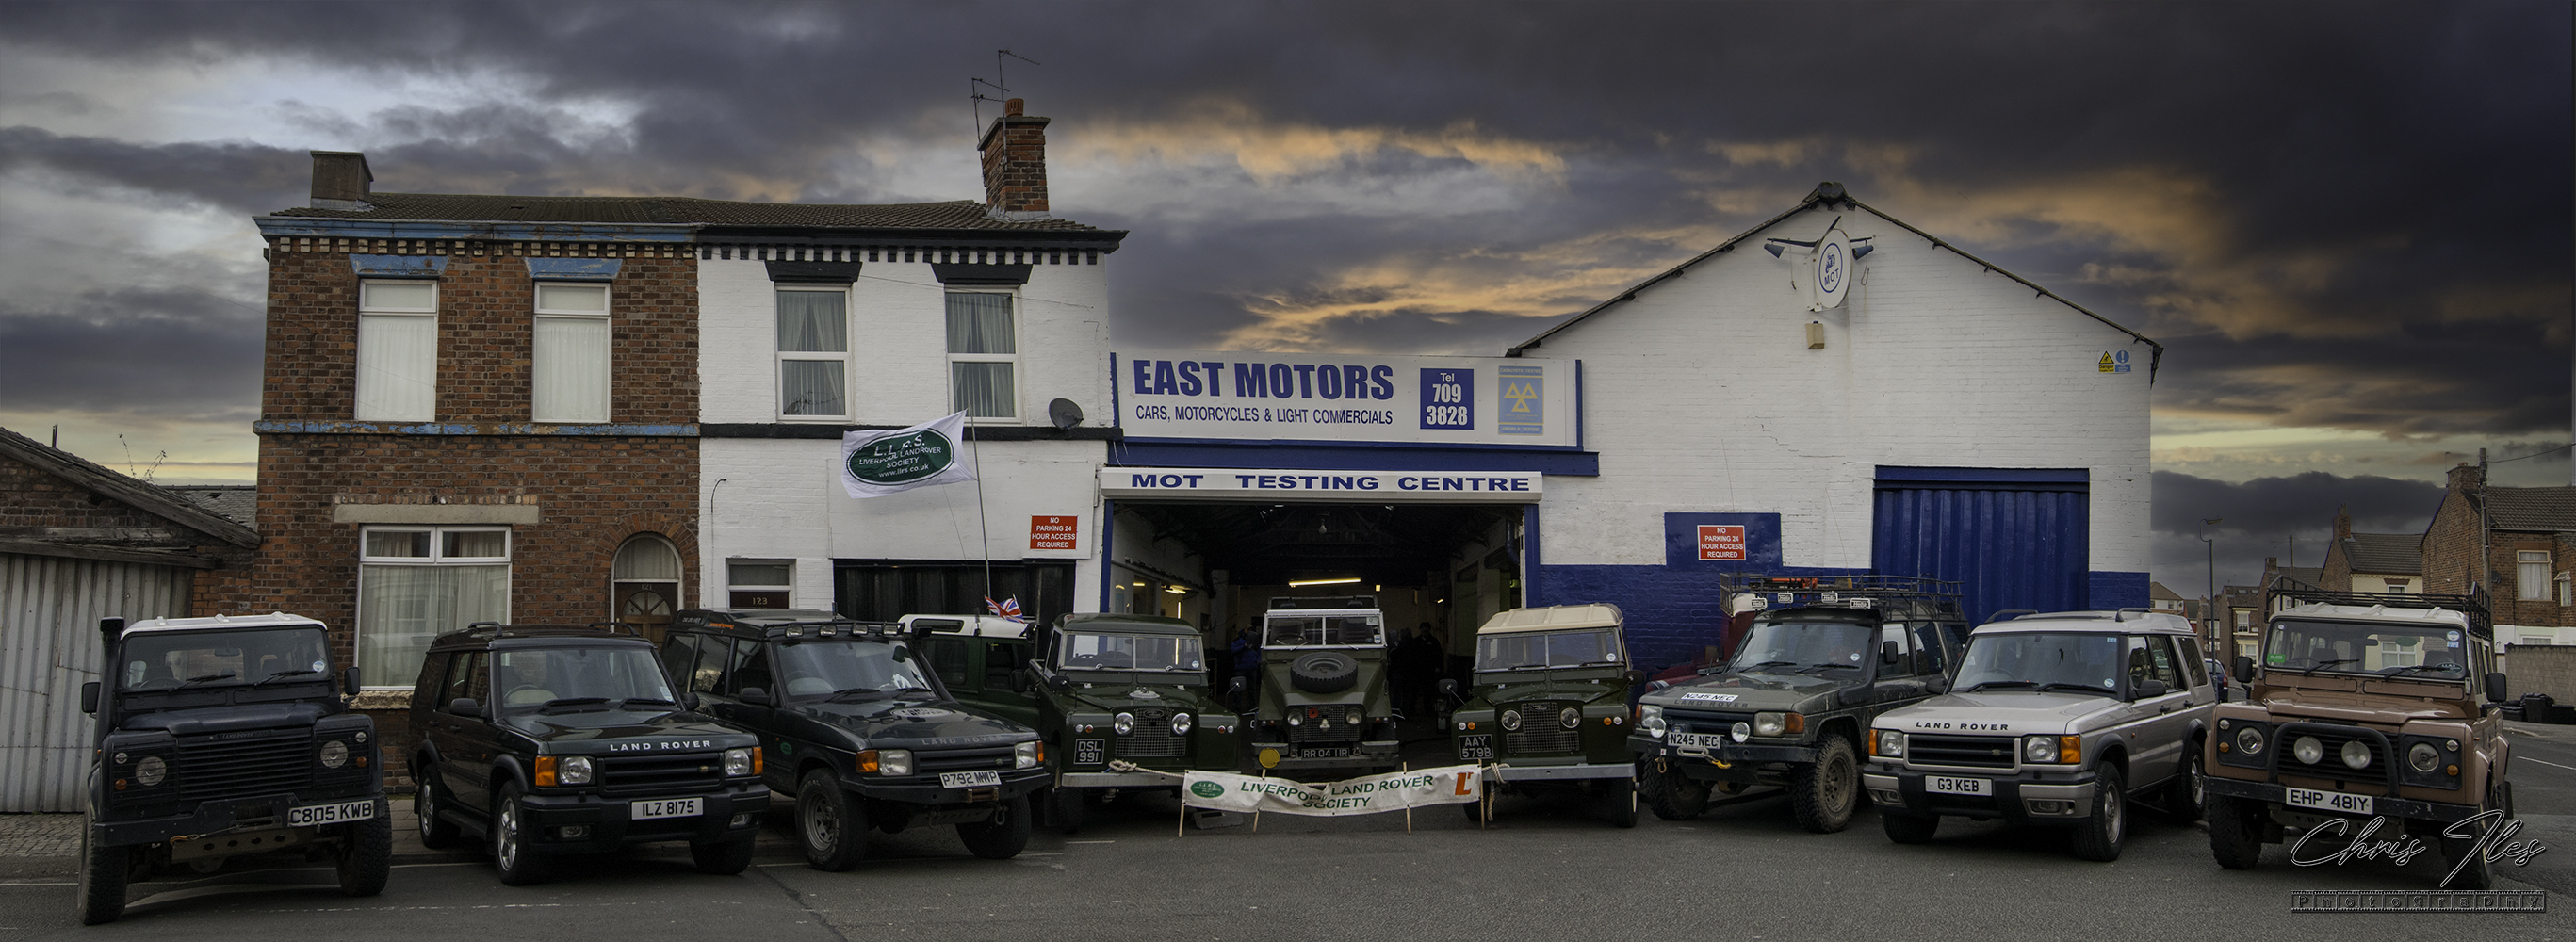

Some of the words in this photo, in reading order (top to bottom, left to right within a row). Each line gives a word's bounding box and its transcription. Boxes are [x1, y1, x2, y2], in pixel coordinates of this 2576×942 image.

[1824, 268, 1839, 286] MOT
[1133, 359, 1224, 396] EAST
[1234, 363, 1394, 400] MOTORS
[1440, 373, 1454, 382] Tel
[1432, 384, 1462, 403] 709
[1136, 405, 1171, 423] CARS,
[1175, 406, 1259, 422] MOTORCYCLES
[1264, 409, 1272, 422] &
[1277, 408, 1308, 423] LIGHT
[1313, 409, 1393, 424] COMMERCIALS
[1426, 406, 1467, 426] 3828
[900, 447, 942, 457] LANDROVER
[886, 457, 919, 469] SOCIETY
[879, 464, 929, 477] www.llrsco.uk
[1132, 474, 1204, 488] MOT
[1235, 475, 1378, 490] TESTING
[1398, 476, 1529, 491] CENTRE
[610, 743, 651, 751] LAND
[661, 741, 711, 749] ROVER
[922, 738, 956, 746] LAND
[964, 734, 1003, 743] ROVER
[1078, 741, 1101, 752] DSL
[1464, 737, 1486, 747] AAY
[1670, 735, 1694, 745] N245
[1698, 736, 1718, 746] NEC
[1079, 752, 1098, 762] 991
[1303, 750, 1316, 758] RR
[1318, 749, 1331, 757] 04
[1462, 748, 1491, 758] 579B
[942, 773, 974, 786] P792
[977, 772, 997, 784] MWP
[1332, 784, 1374, 795] LAND
[1379, 776, 1433, 791] ROVER
[1938, 778, 1953, 790] G3
[1955, 779, 1979, 792] KEB
[1303, 797, 1371, 809] SOCIETY
[2291, 790, 2323, 805] EHP
[2331, 794, 2368, 811] 481Y
[290, 807, 335, 824] C805
[340, 802, 372, 819] KWB
[642, 802, 662, 816] ILZ
[667, 801, 694, 815] 8175
